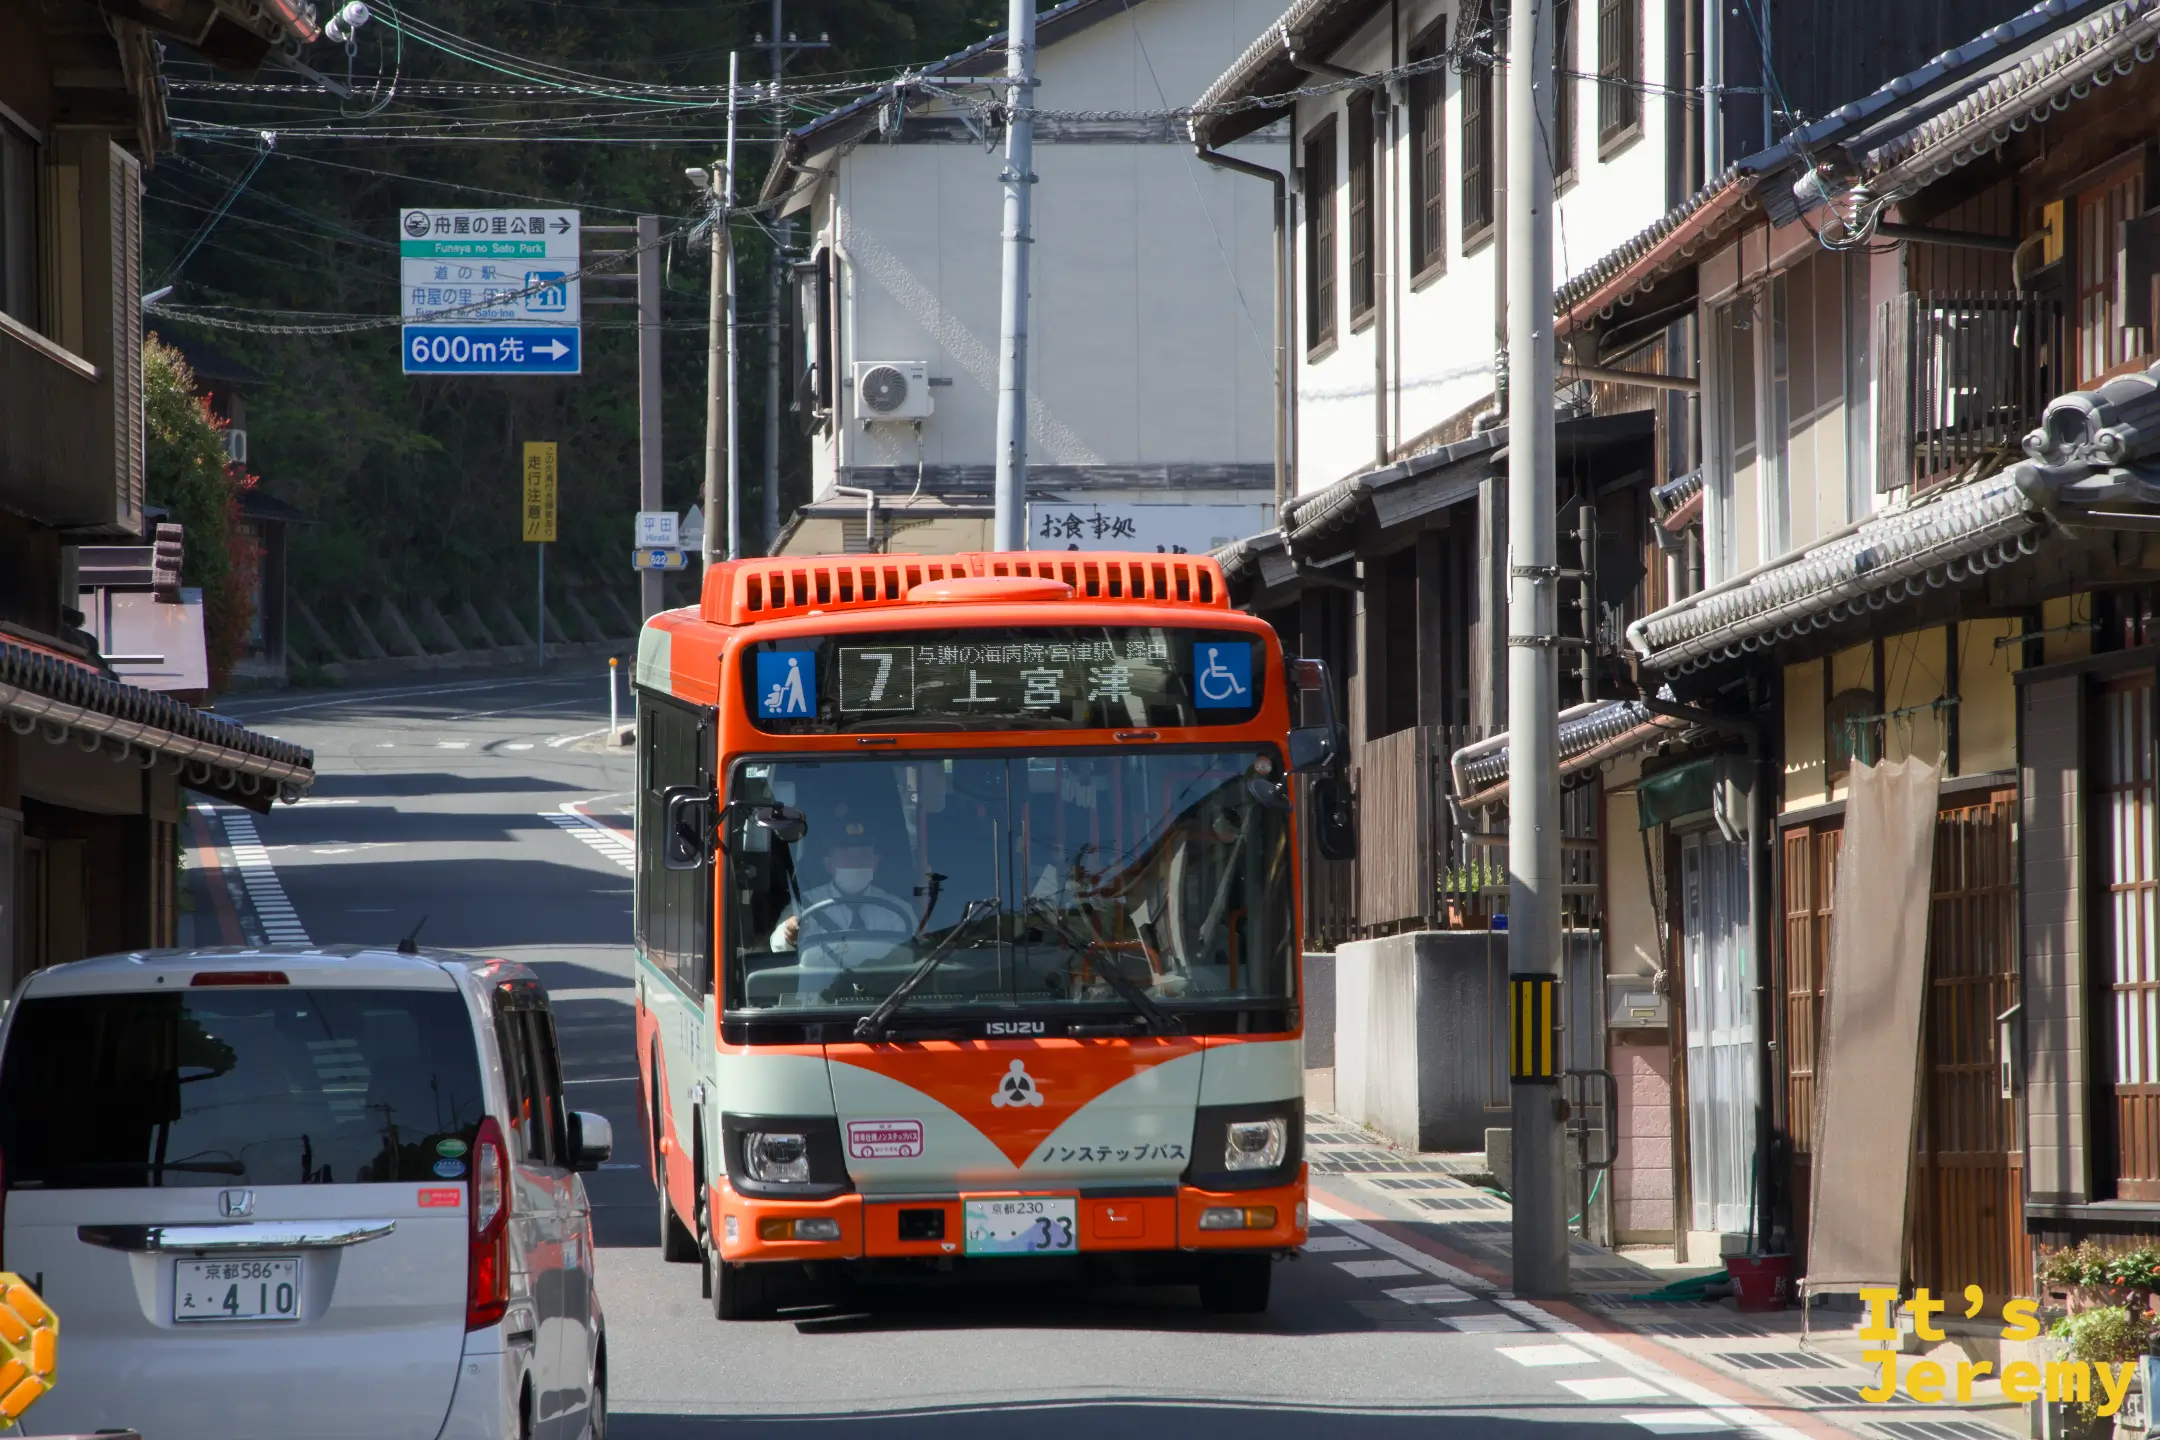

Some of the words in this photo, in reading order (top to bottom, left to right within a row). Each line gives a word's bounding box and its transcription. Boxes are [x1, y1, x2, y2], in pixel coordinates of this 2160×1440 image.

[434, 216, 545, 235] 舟屋の里公園
[435, 243, 471, 255] Funaya
[475, 245, 488, 253] no
[492, 243, 515, 253] Sato
[519, 243, 543, 253] Park
[434, 265, 497, 280] 道の駅
[411, 287, 472, 306] 舟屋の里
[411, 335, 524, 363] 600m先
[644, 517, 672, 533] 平田
[1039, 512, 1137, 540] お食事処
[645, 533, 670, 542] Hirata
[650, 555, 666, 564] 622
[860, 653, 893, 702] 7
[952, 665, 1134, 705] 上宮津
[986, 1021, 1045, 1035] ISUZU
[1042, 1143, 1186, 1163] ノンステップバス
[204, 1262, 272, 1280] 京都586
[183, 1292, 196, 1308] え
